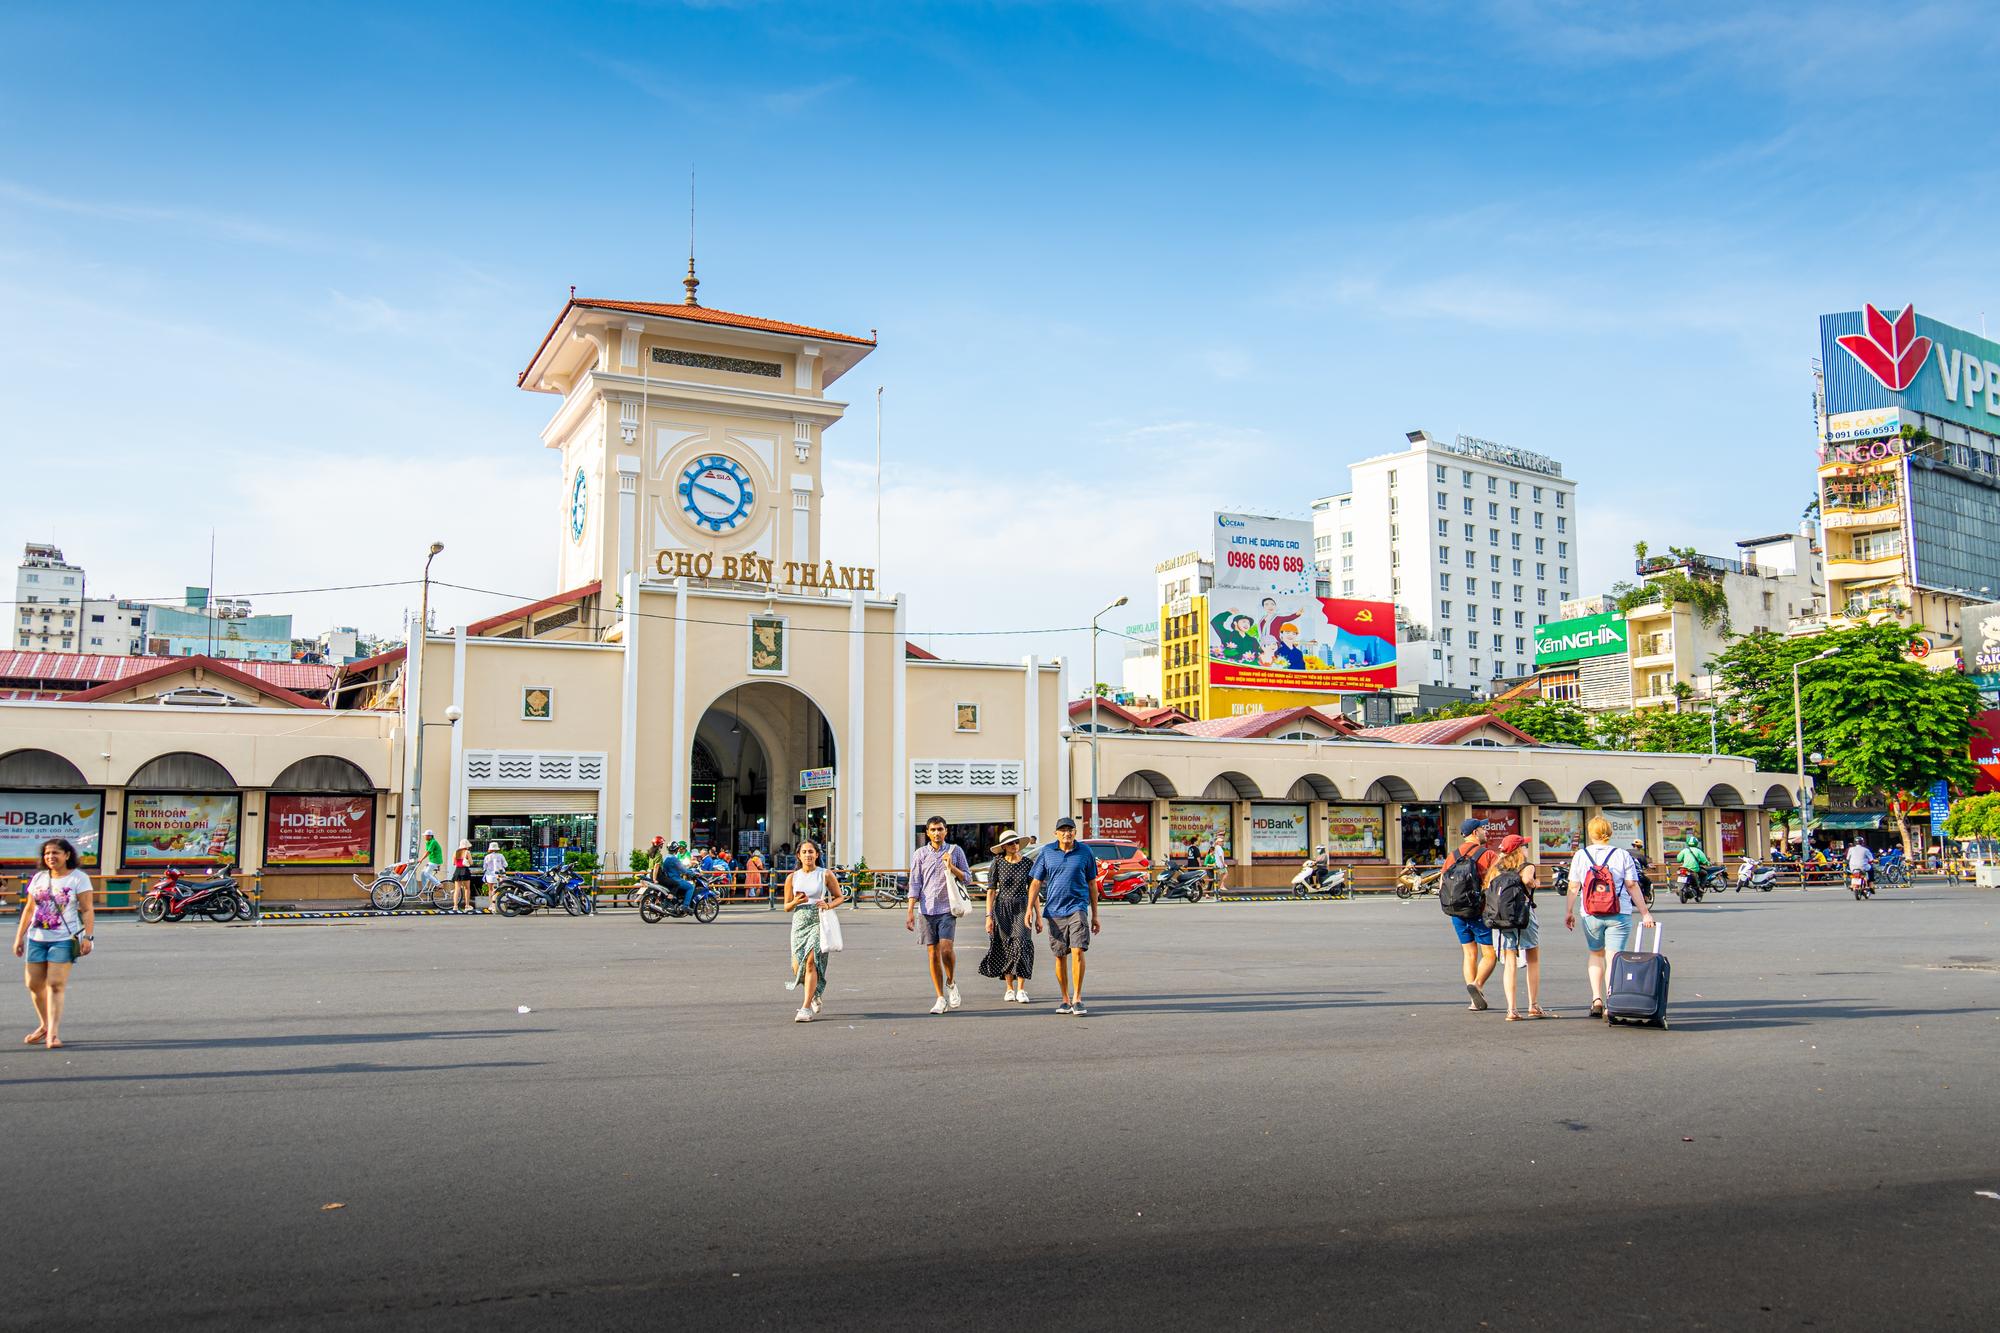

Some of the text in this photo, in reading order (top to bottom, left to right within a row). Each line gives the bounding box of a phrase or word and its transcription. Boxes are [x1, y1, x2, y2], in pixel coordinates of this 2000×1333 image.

[1835, 425, 1895, 439] 091 666 0593
[1227, 550, 1304, 573] 0986 669 689
[656, 550, 875, 591] CHỢ BẾN THÀNH
[280, 813, 347, 827] HDBank
[1089, 818, 1133, 829] DBank
[1253, 819, 1294, 829] HDBank
